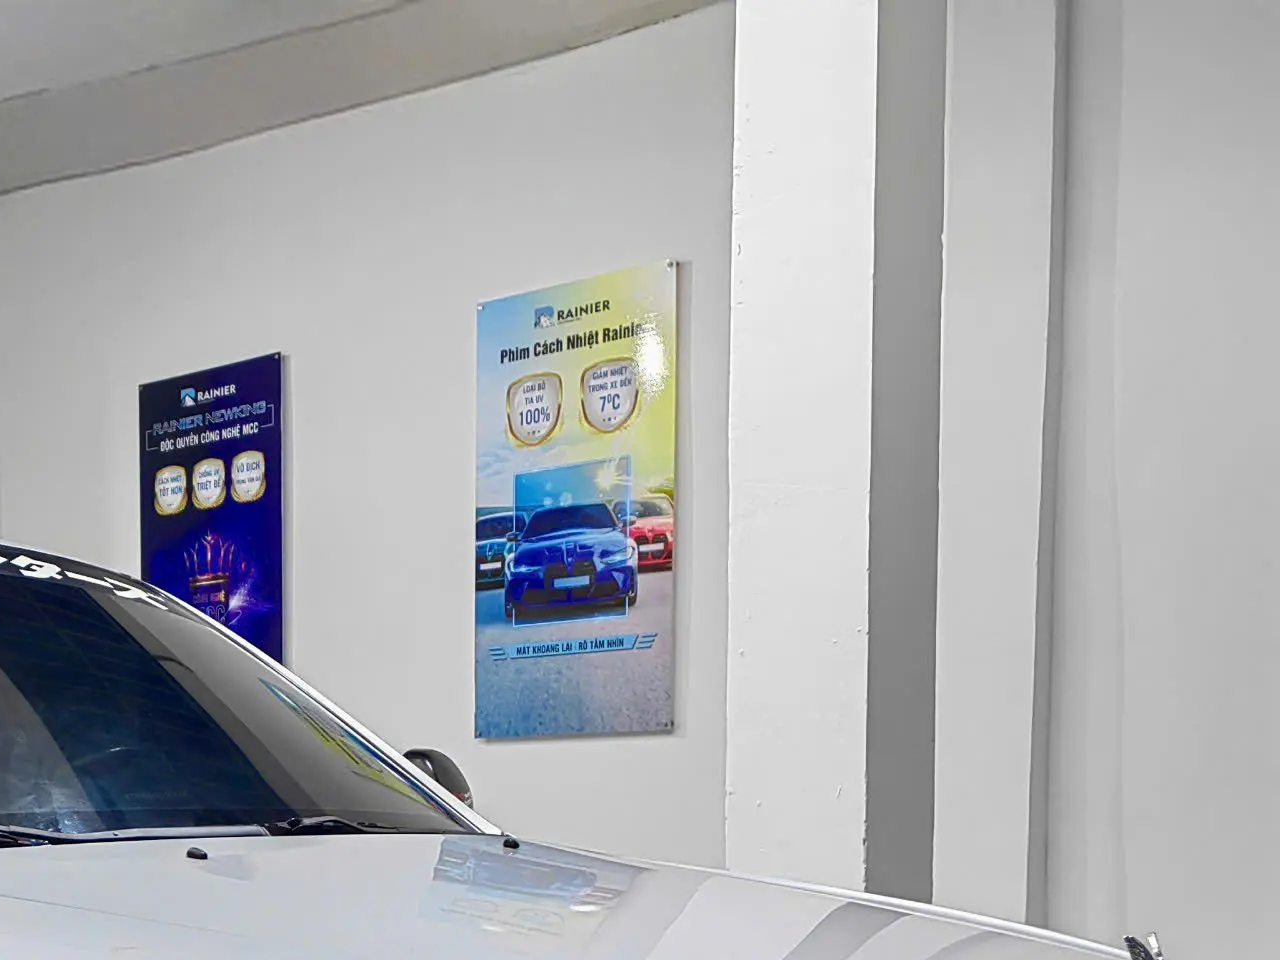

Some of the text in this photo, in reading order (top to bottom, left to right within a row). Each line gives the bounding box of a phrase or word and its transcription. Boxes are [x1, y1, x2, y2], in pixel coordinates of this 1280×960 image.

[557, 300, 610, 321] RAINIER
[500, 344, 530, 364] Phim
[533, 336, 563, 357] Cách
[566, 329, 599, 349] Nhiệt
[197, 384, 236, 401] RAINIER
[535, 394, 544, 404] UV
[519, 406, 551, 427] 100%
[242, 422, 259, 435] MCC
